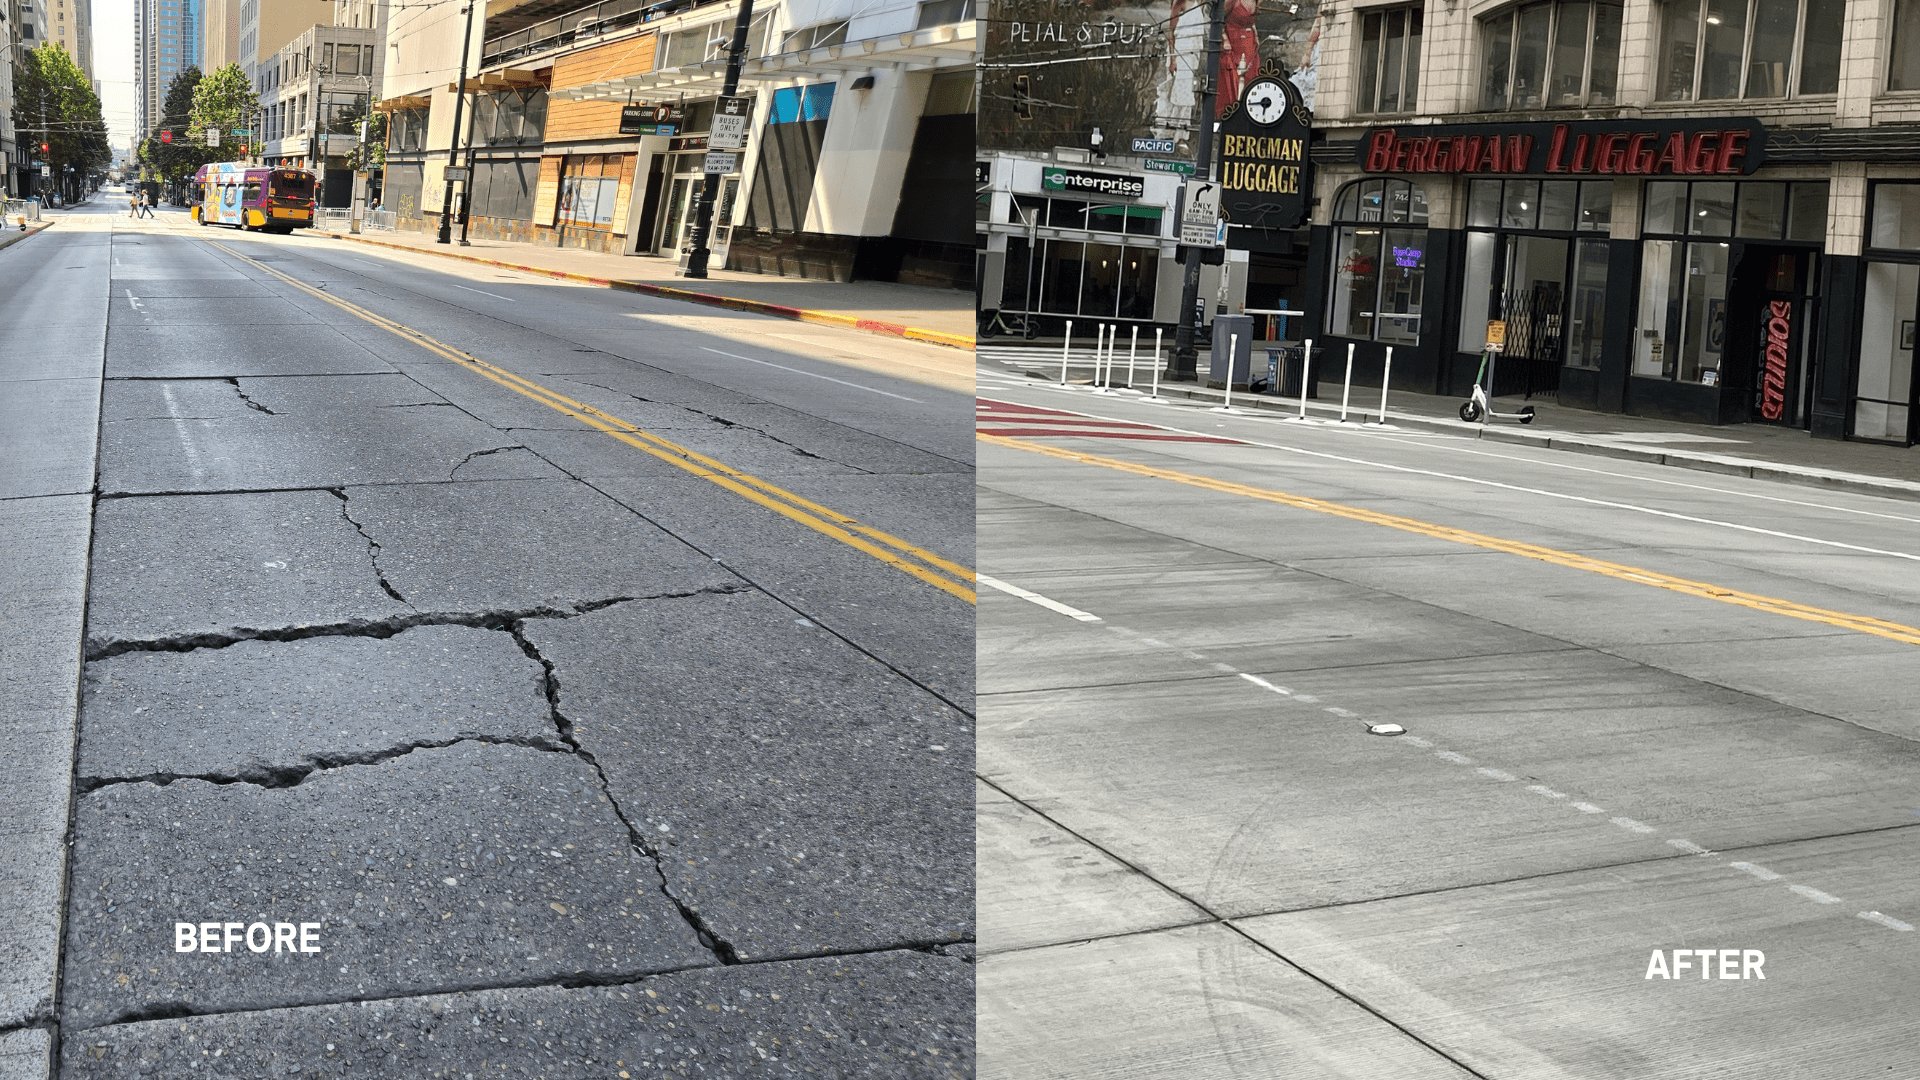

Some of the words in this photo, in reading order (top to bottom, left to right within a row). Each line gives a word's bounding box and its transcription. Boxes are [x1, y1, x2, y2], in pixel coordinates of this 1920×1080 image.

[1077, 21, 1092, 43] &
[719, 117, 740, 125] BUSES
[720, 124, 737, 132] ONLY
[1134, 141, 1172, 151] PACIFIC
[1223, 134, 1303, 161] BERGMAN
[1365, 126, 1533, 174] BERGMAN
[1545, 123, 1751, 175] LUGGAGE
[1146, 160, 1175, 171] Stewart
[1045, 173, 1143, 192] enterprise
[1222, 161, 1300, 194] LUGGAGE
[1108, 189, 1142, 197] rent-a-car
[1192, 201, 1211, 210] ONLY
[1761, 300, 1791, 420] STUDIOS
